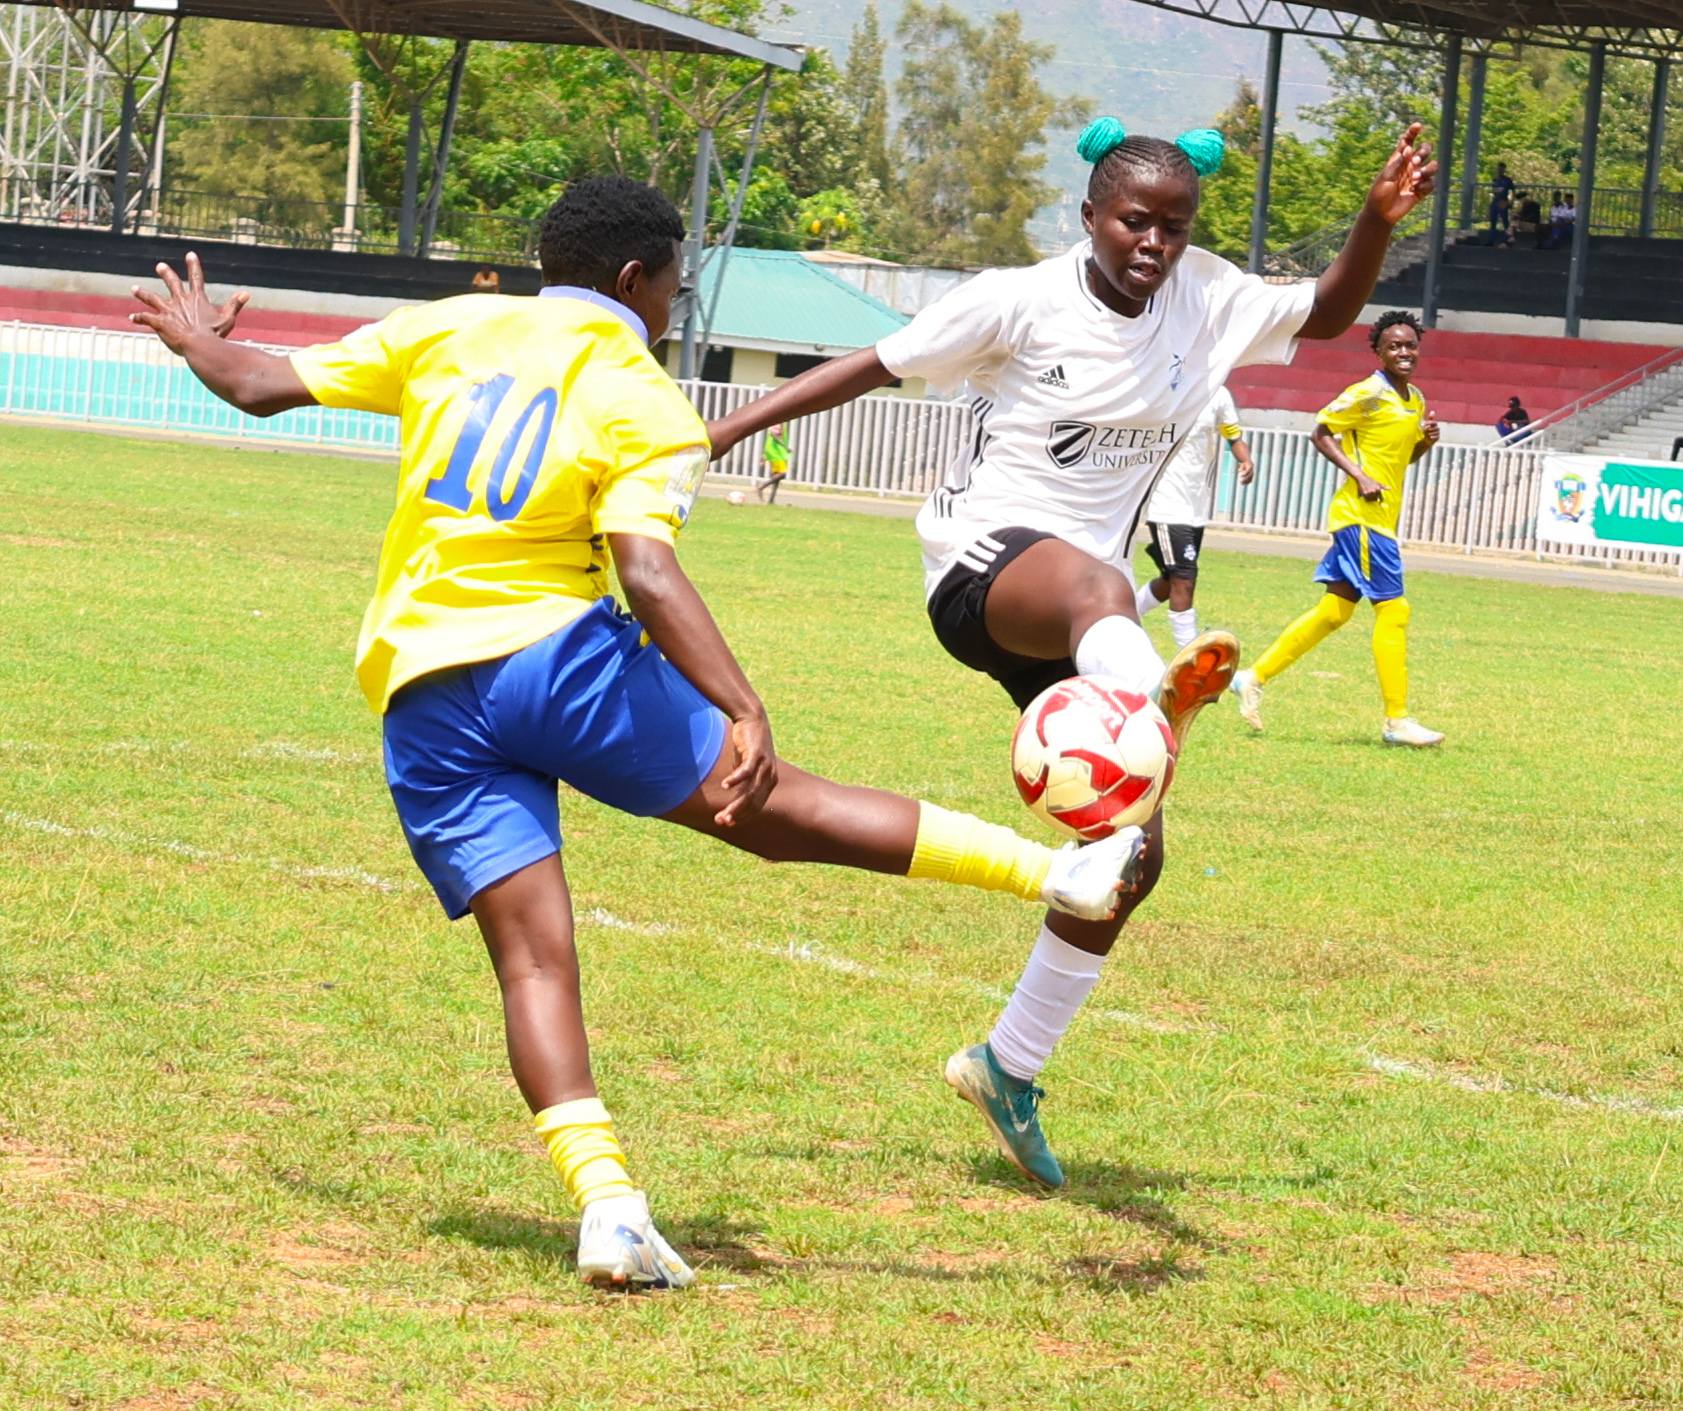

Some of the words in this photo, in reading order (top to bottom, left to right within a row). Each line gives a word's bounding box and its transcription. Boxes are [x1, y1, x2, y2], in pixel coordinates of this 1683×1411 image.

[1037, 375, 1069, 390] adidas
[424, 372, 558, 522] 10
[1097, 422, 1177, 449] ZETEH
[1600, 482, 1683, 523] VIHIG
